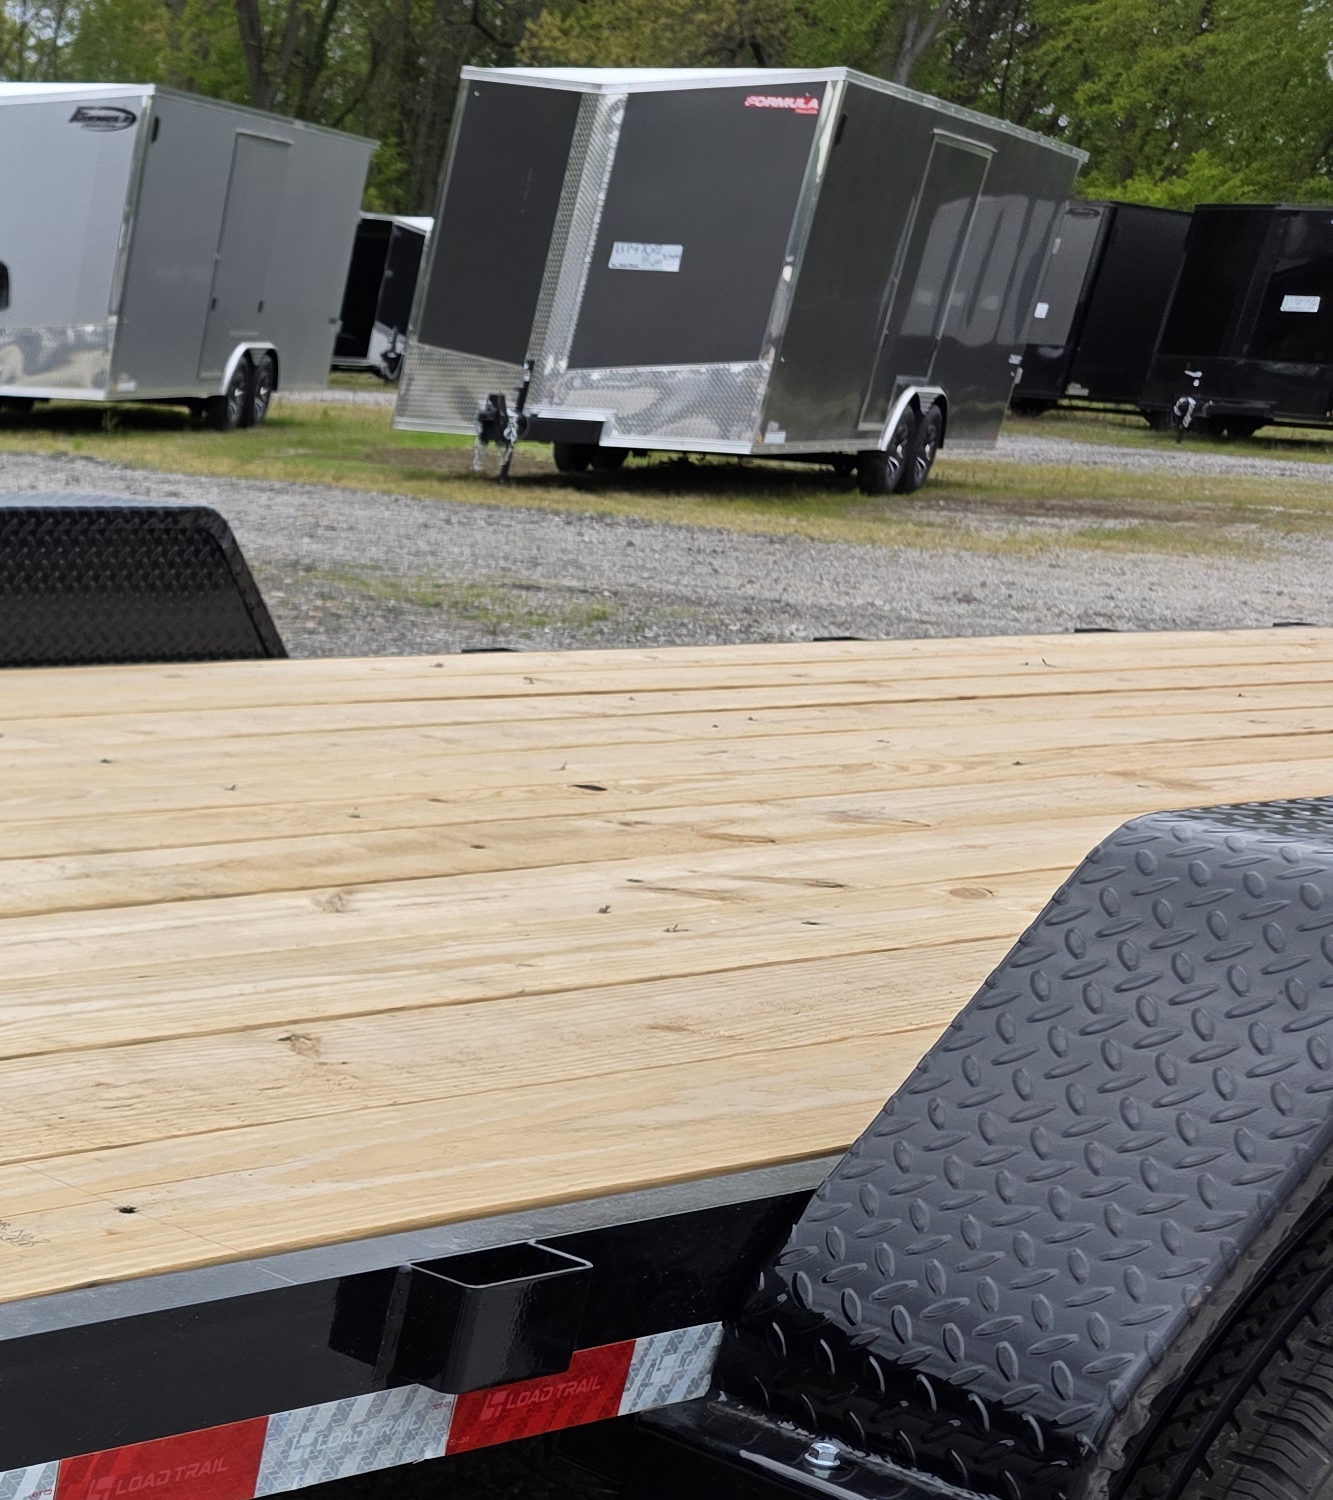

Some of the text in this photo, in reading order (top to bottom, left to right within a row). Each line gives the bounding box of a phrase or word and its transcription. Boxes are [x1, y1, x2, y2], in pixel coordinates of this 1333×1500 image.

[745, 95, 819, 109] FORMULA
[507, 1376, 601, 1409] LOAD TRAIL
[317, 1414, 420, 1450] LOAD TRAIL
[115, 1457, 227, 1495] LOAD TRAIL
